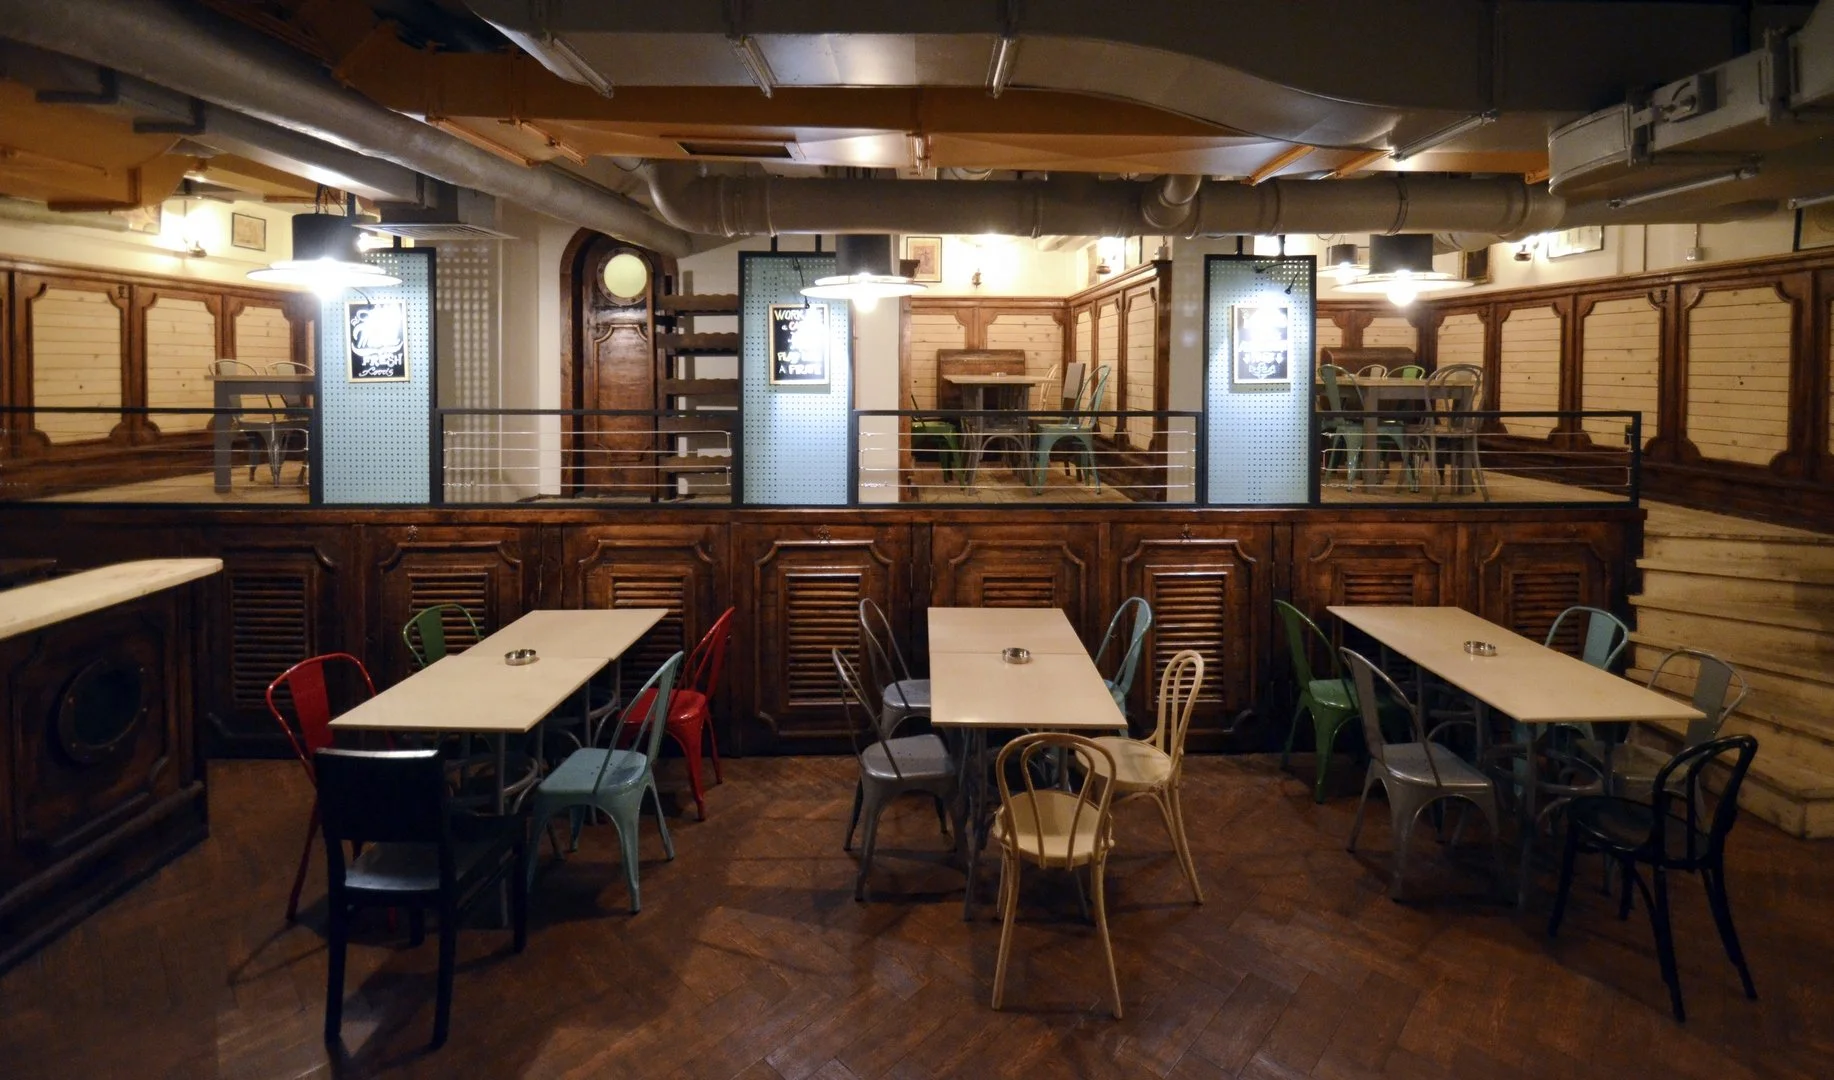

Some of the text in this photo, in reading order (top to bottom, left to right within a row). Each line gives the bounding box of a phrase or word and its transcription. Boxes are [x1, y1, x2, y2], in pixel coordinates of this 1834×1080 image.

[774, 309, 804, 321] WORK
[362, 352, 403, 367] FRESH
[779, 364, 821, 375] A PIRAT
